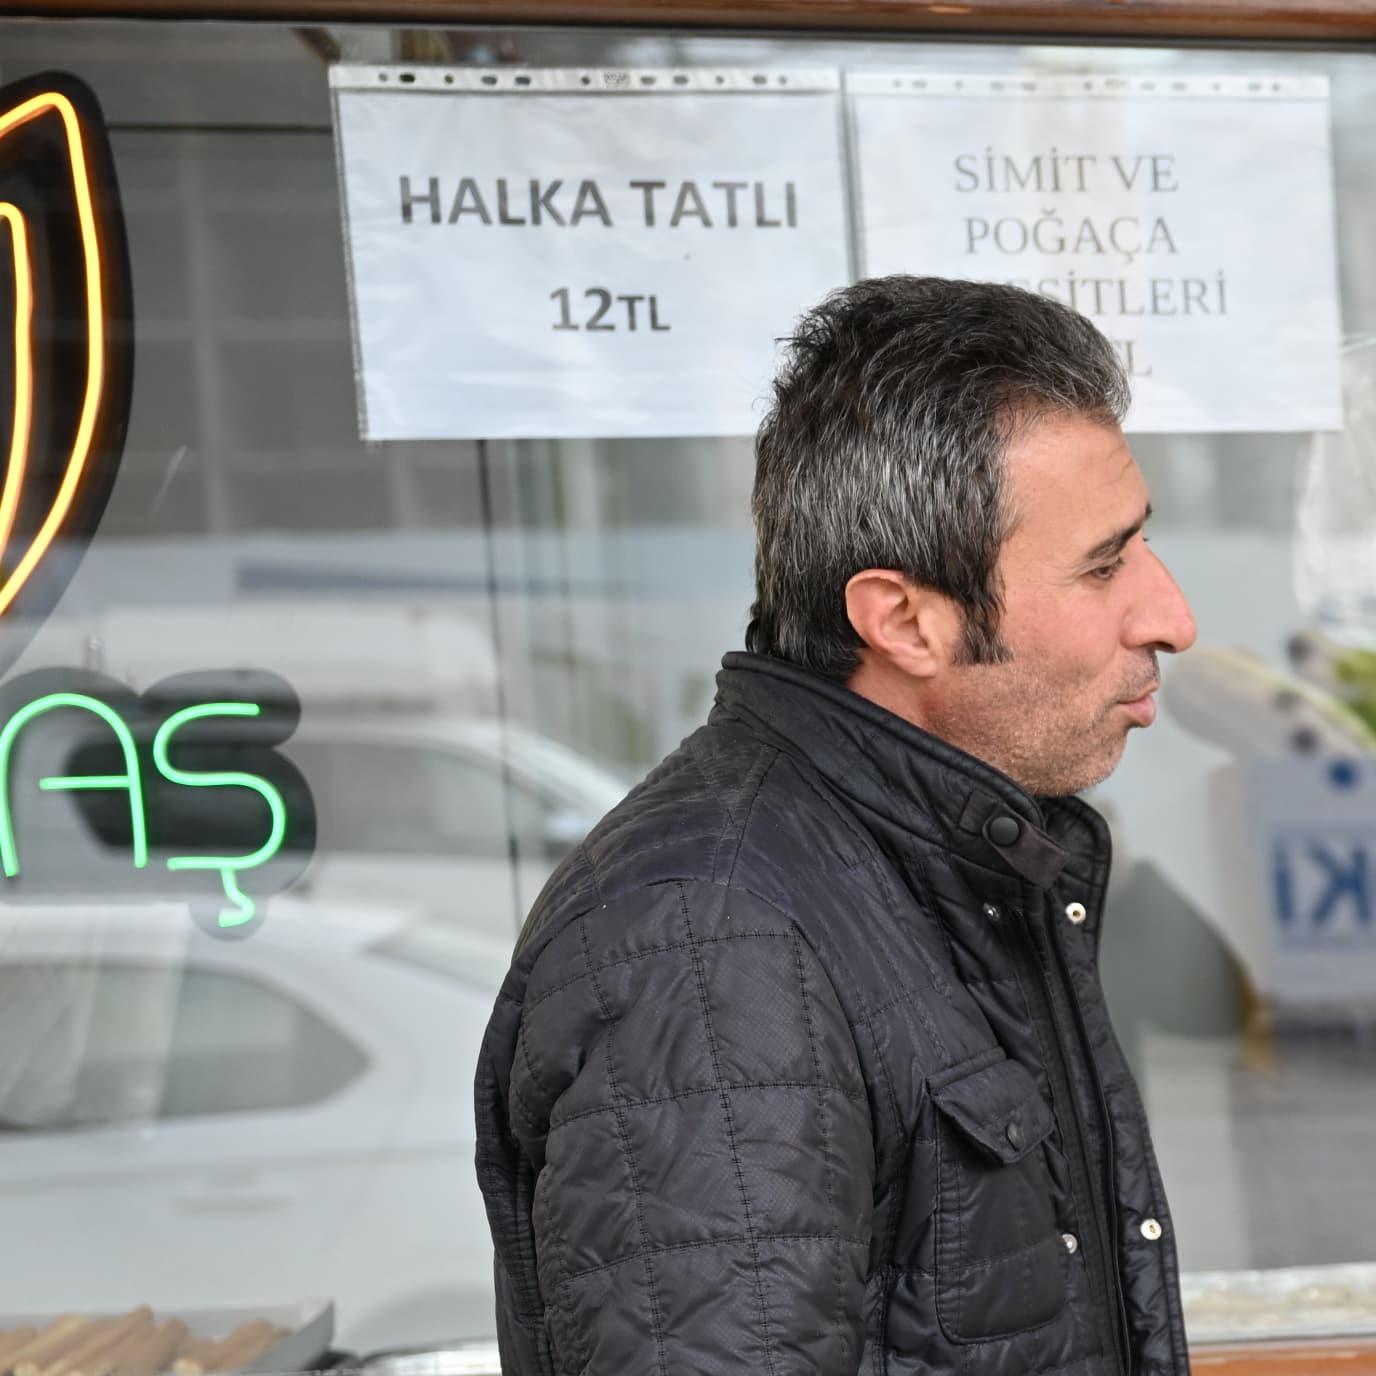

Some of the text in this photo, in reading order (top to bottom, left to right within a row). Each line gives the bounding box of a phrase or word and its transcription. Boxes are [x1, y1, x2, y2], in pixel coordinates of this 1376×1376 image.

[954, 146, 1179, 193] SİMİT VE
[400, 176, 798, 228] HALKA TATLI
[964, 208, 1180, 264] POĞAÇA
[550, 287, 671, 332] 12TL
